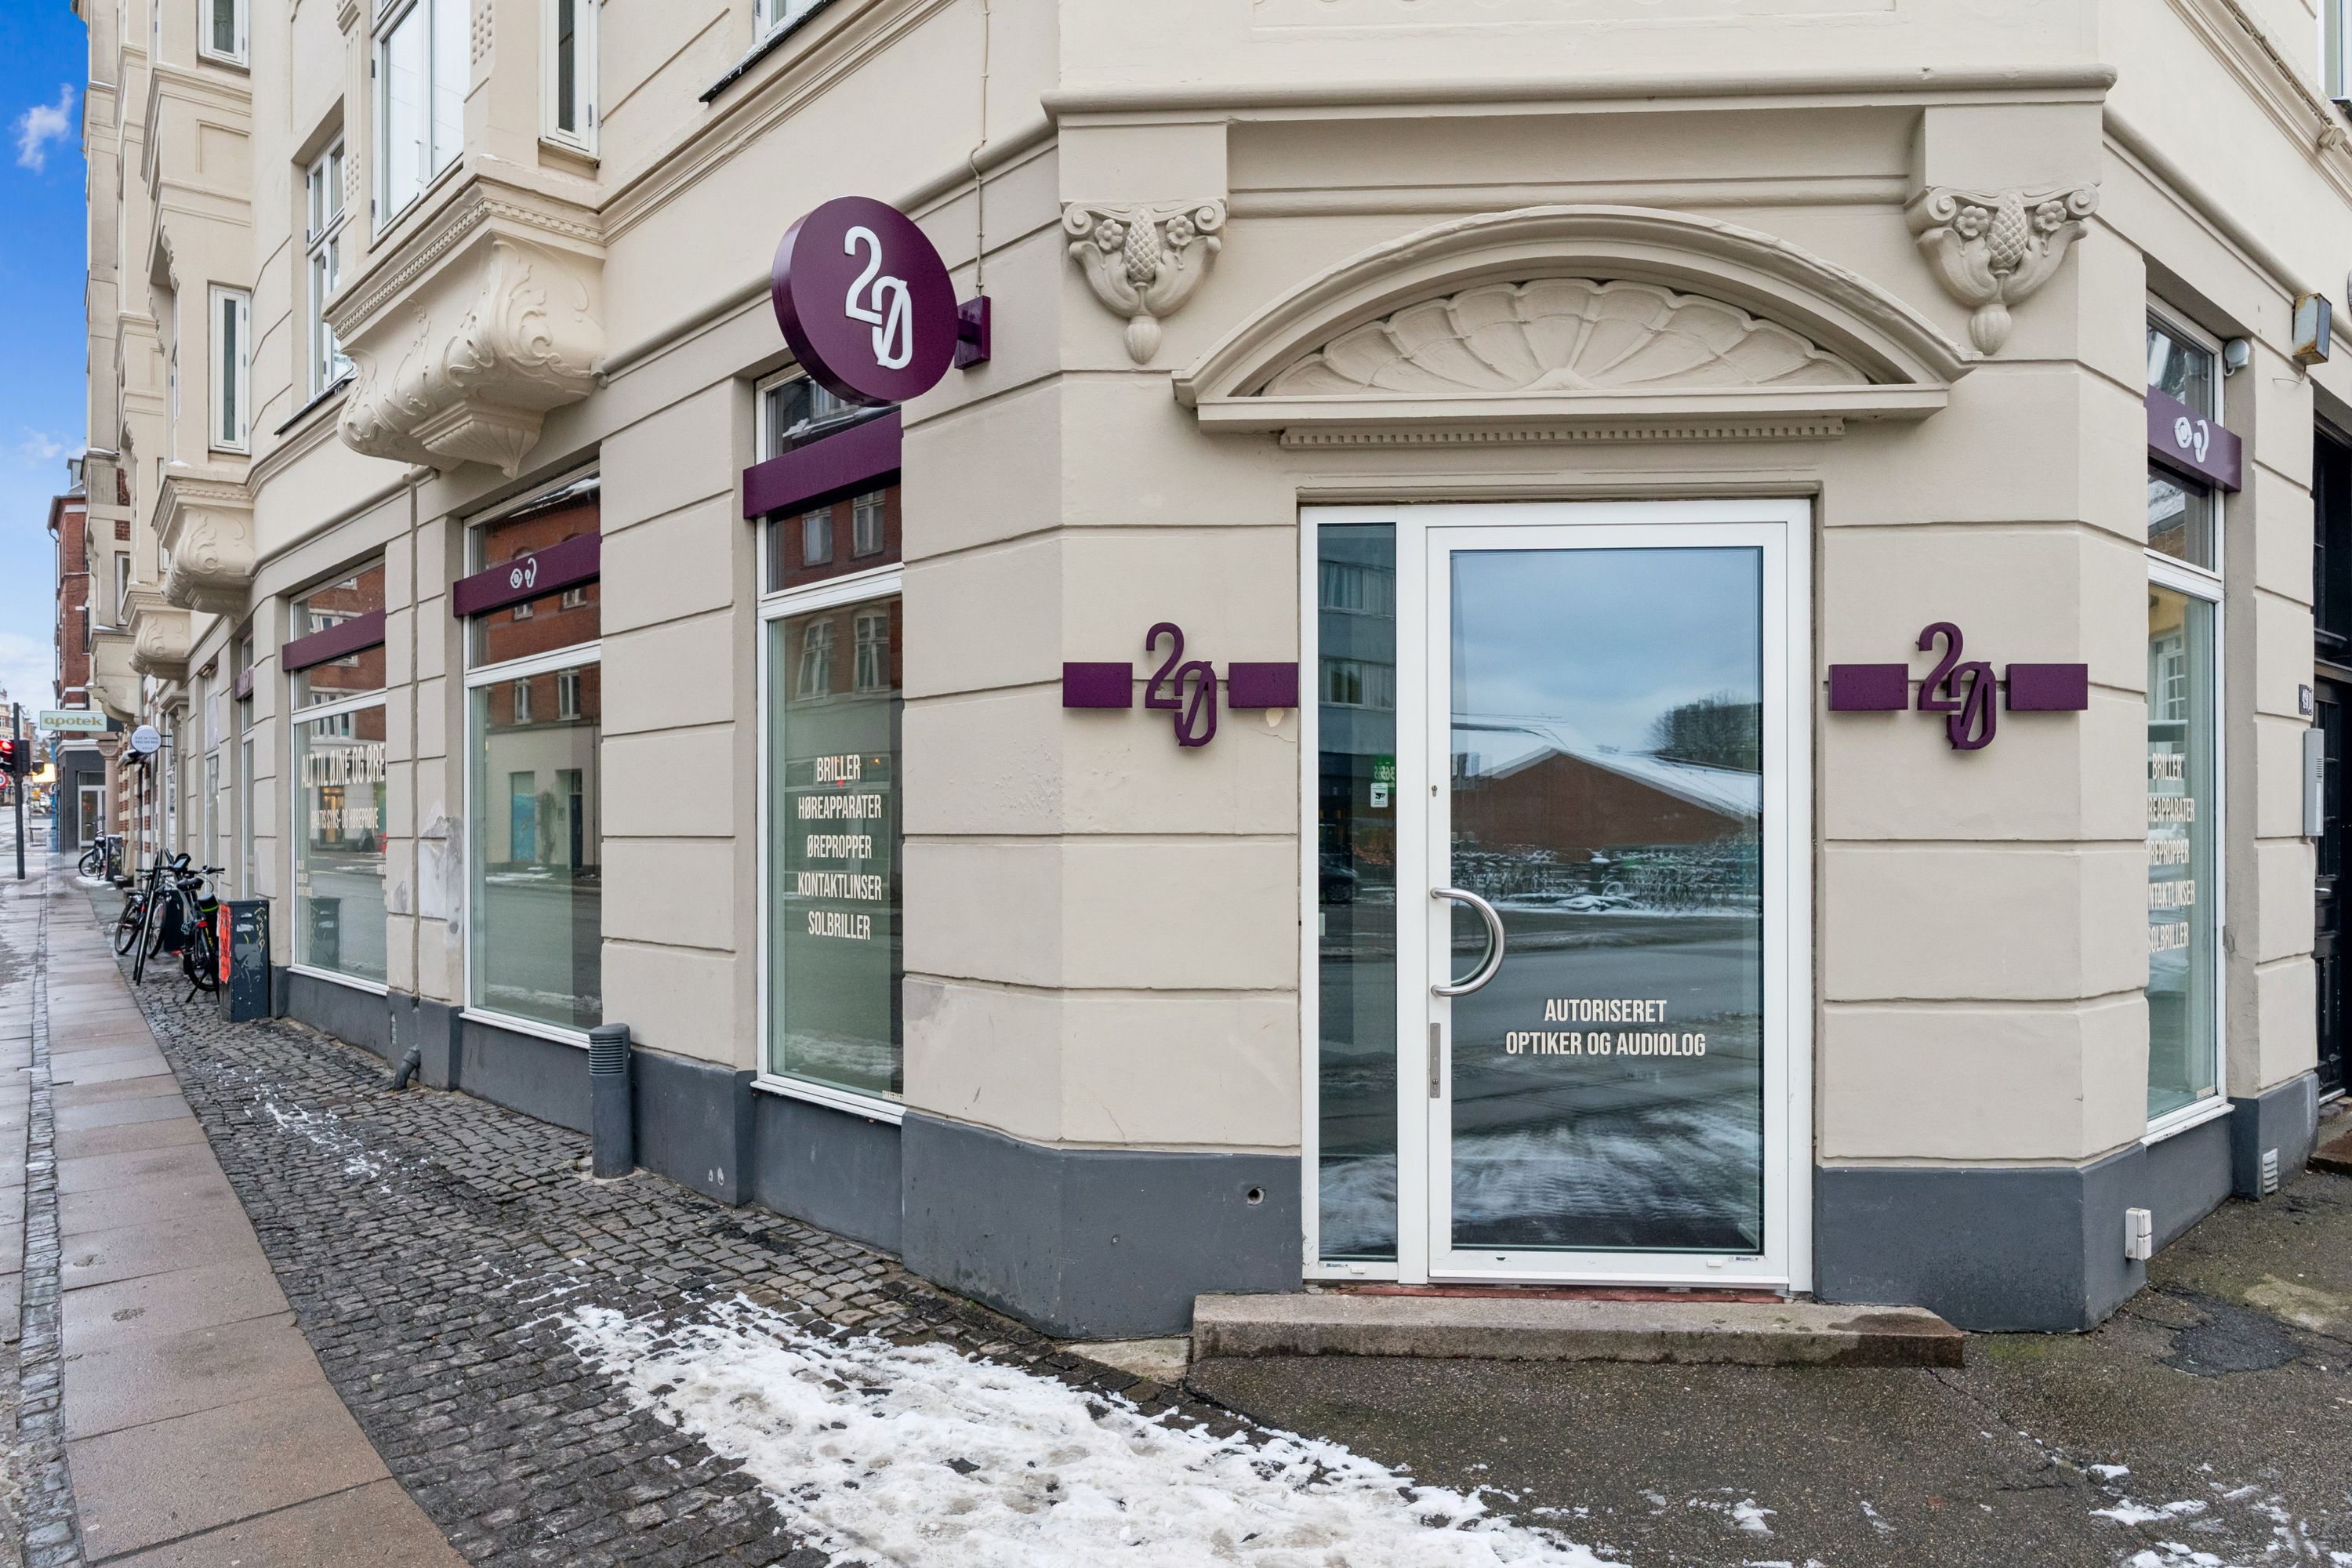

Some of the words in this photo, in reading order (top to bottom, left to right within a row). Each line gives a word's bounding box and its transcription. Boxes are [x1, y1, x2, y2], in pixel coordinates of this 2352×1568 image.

[44, 717, 103, 728] apotek
[301, 753, 314, 788] ALT
[316, 753, 328, 786] TIL
[330, 748, 350, 786] ØJNE
[352, 746, 364, 784] OG
[366, 742, 386, 783] ØRE
[817, 754, 861, 782] BRILLER
[2152, 753, 2182, 781] BRILLER
[342, 808, 348, 829] OG
[798, 794, 881, 819] HØREAPPARATER
[2148, 797, 2195, 822] REAPPARATER
[807, 834, 872, 858] ØREPROPPER
[798, 872, 882, 901] KONTAKTLINSER
[2148, 880, 2195, 909] NTAKTLINSER
[808, 910, 870, 940] SOLBRILLER
[1544, 998, 1667, 1022] AUTORISERET
[1505, 1031, 1582, 1054] OPTIKER
[1587, 1032, 1611, 1055] OG
[1616, 1033, 1706, 1056] AUDIOLOG
